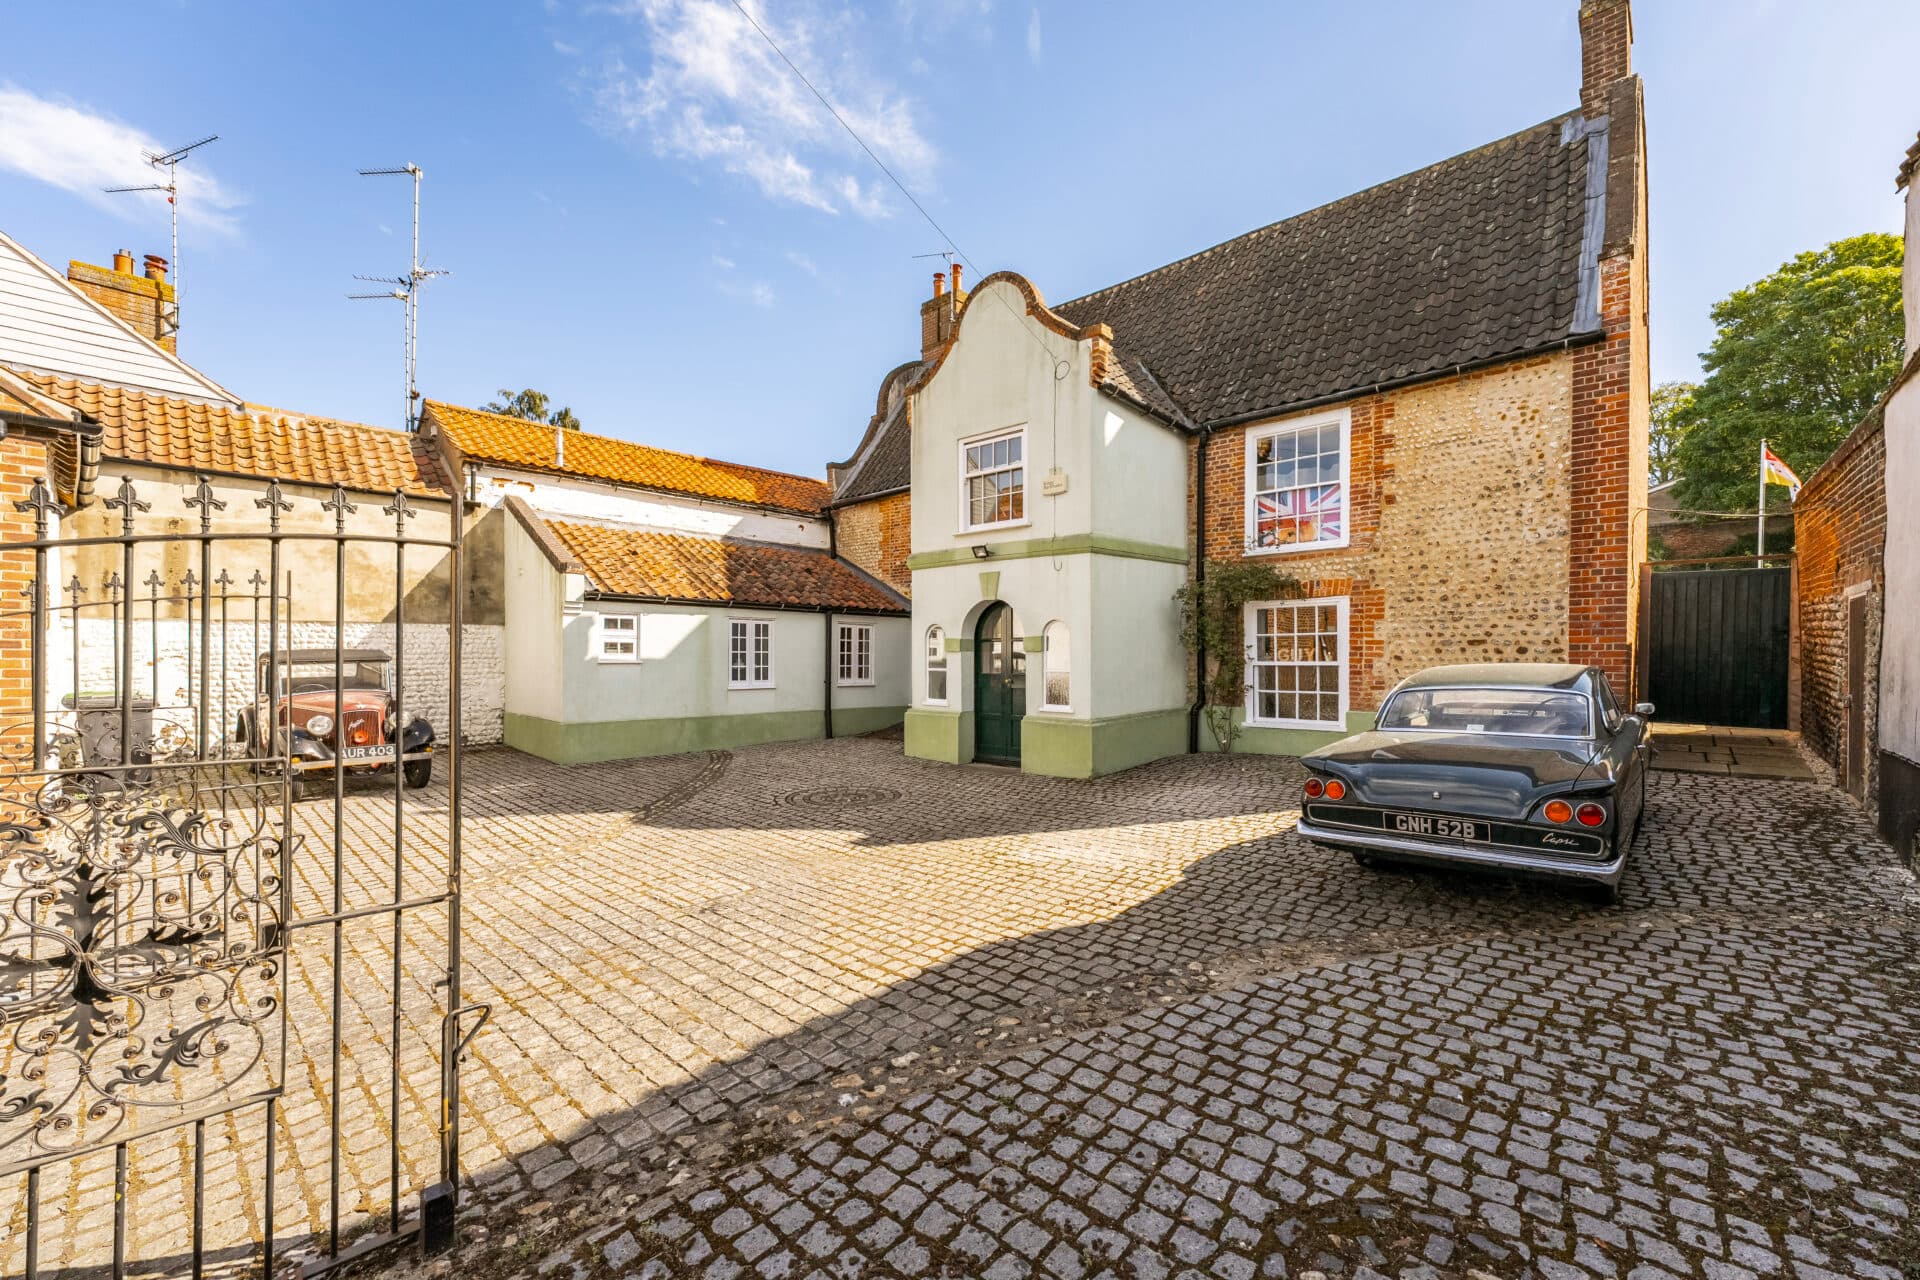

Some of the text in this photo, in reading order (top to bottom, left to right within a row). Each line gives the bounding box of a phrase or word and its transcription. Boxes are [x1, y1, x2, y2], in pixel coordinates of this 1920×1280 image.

[369, 746, 394, 756] 403
[1396, 815, 1475, 839] GNH 52B
